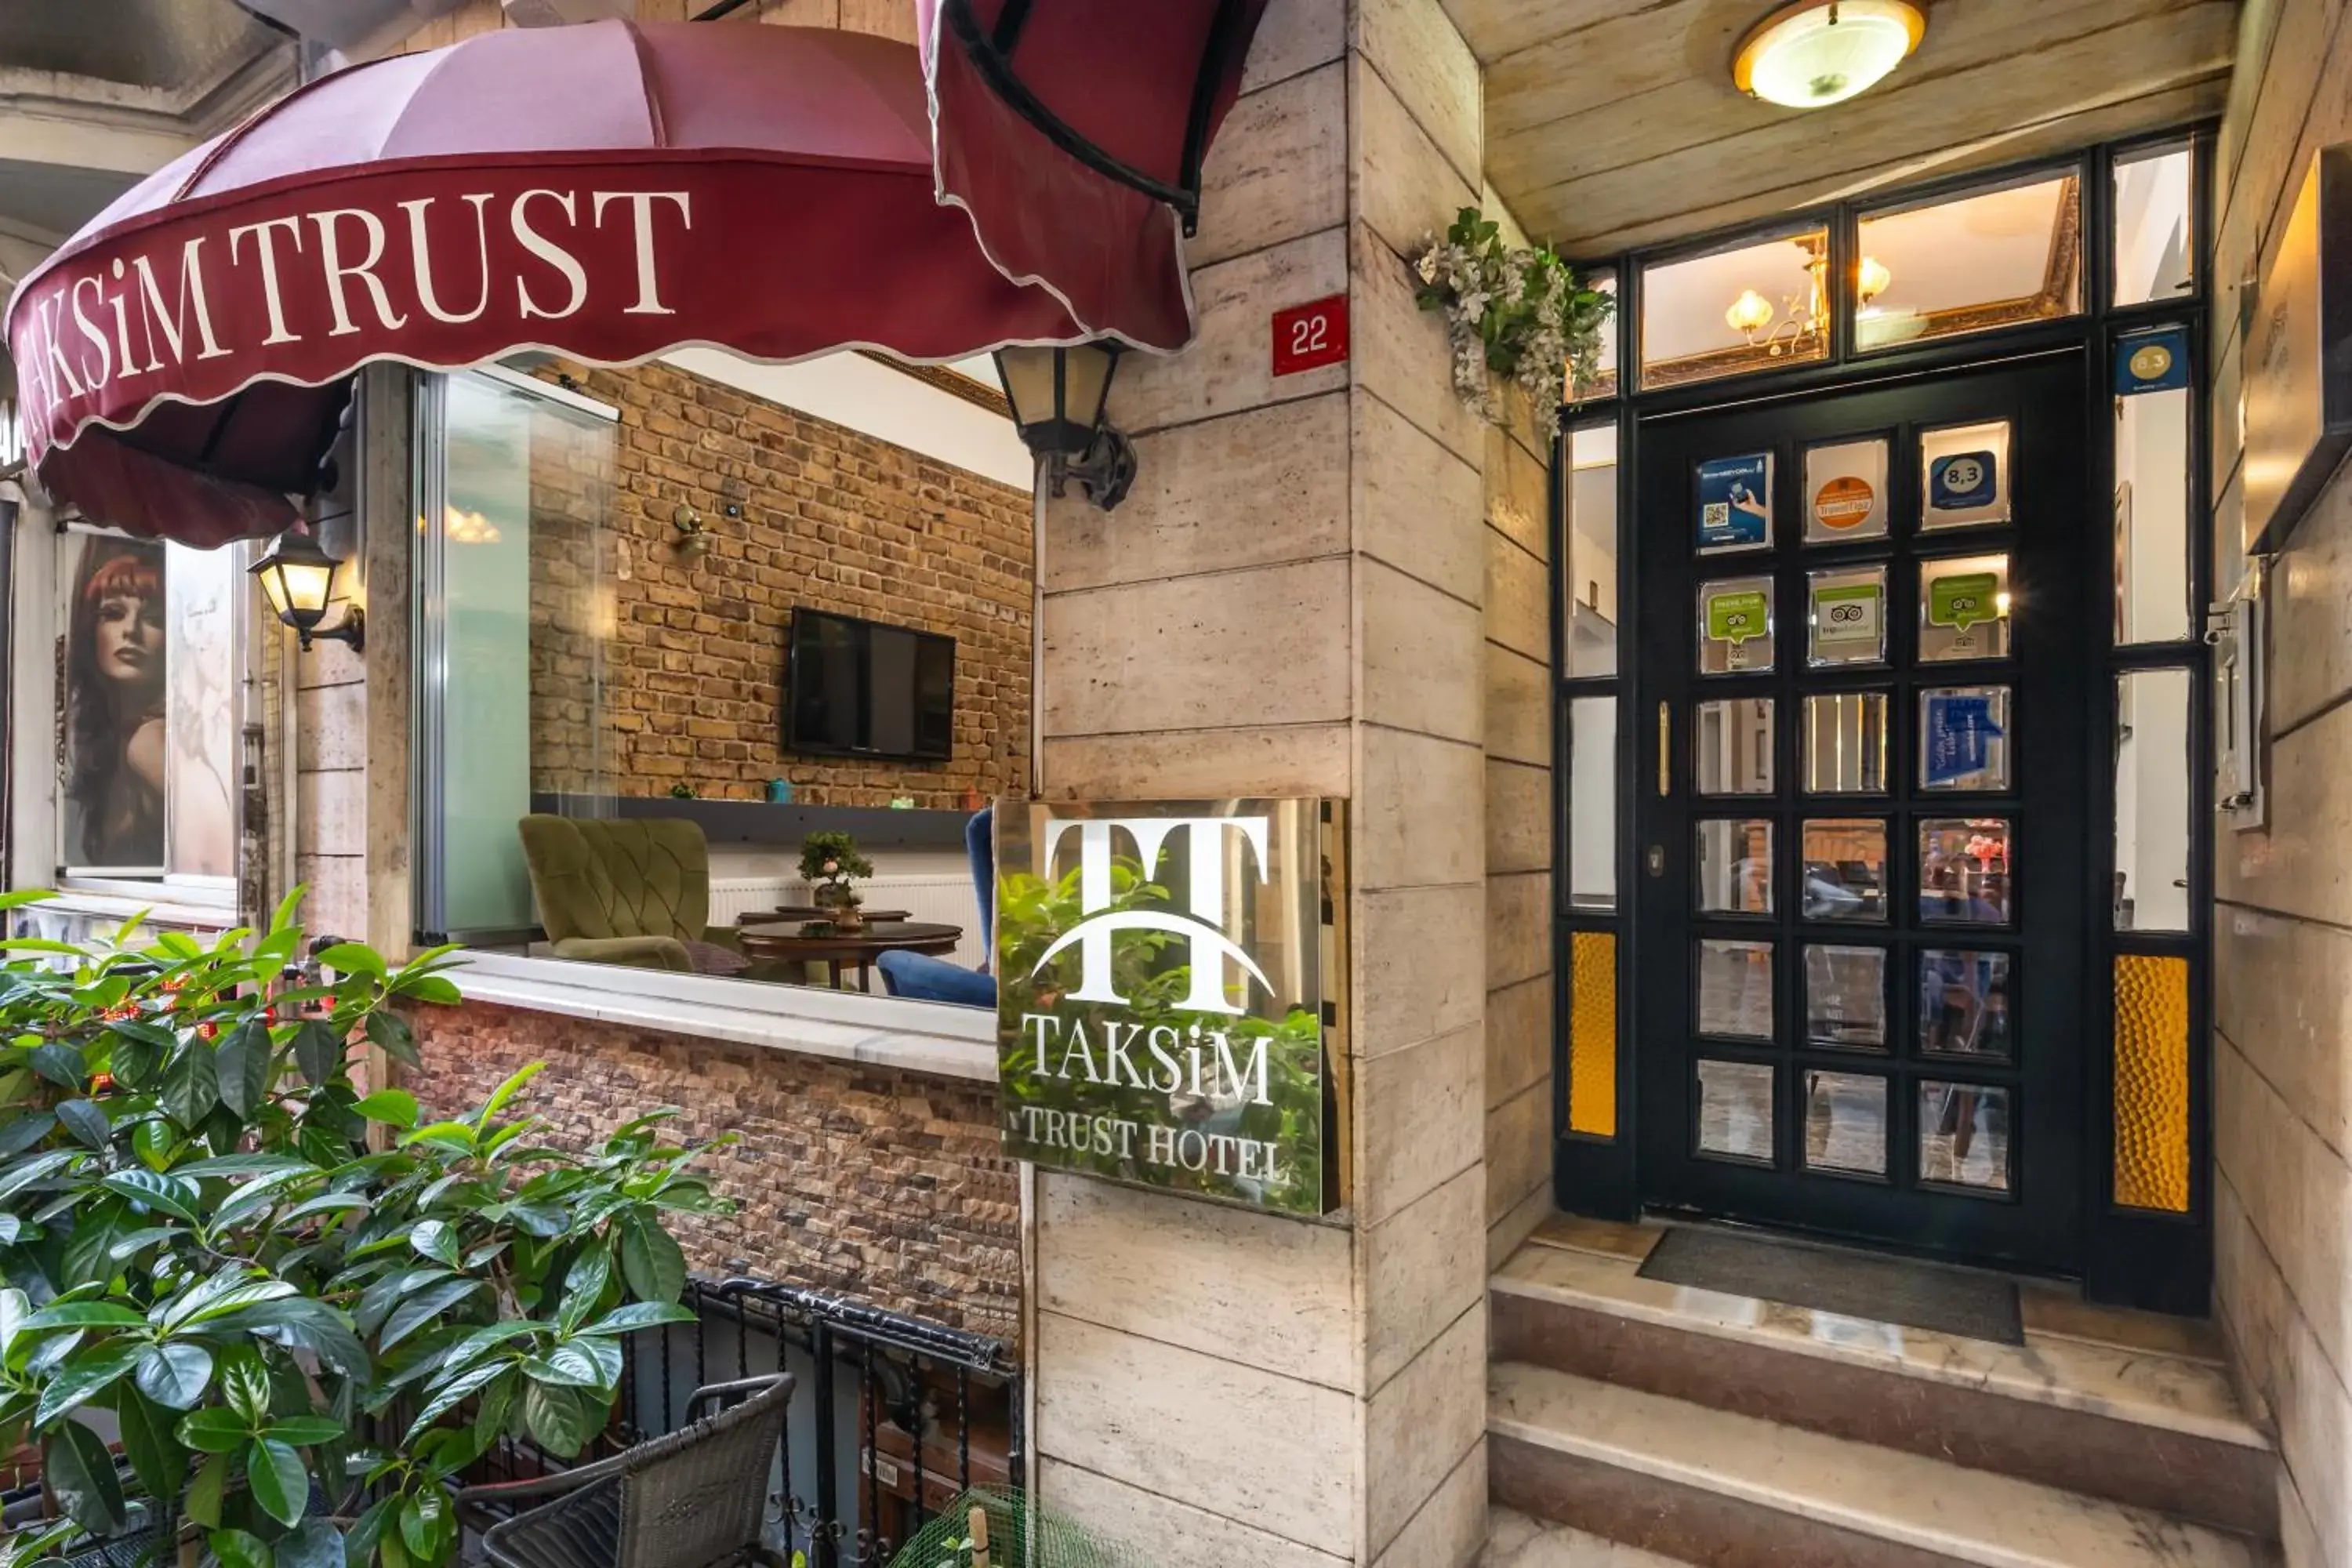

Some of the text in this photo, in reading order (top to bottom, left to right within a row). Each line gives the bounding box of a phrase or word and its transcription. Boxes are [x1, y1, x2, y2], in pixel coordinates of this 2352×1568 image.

[229, 189, 691, 345] TRUST
[1292, 315, 1327, 355] 22
[1948, 466, 1978, 485] 8,3
[1022, 1013, 1275, 1107] TAKSiM
[1021, 1106, 1290, 1186] TRUST HOTEL
